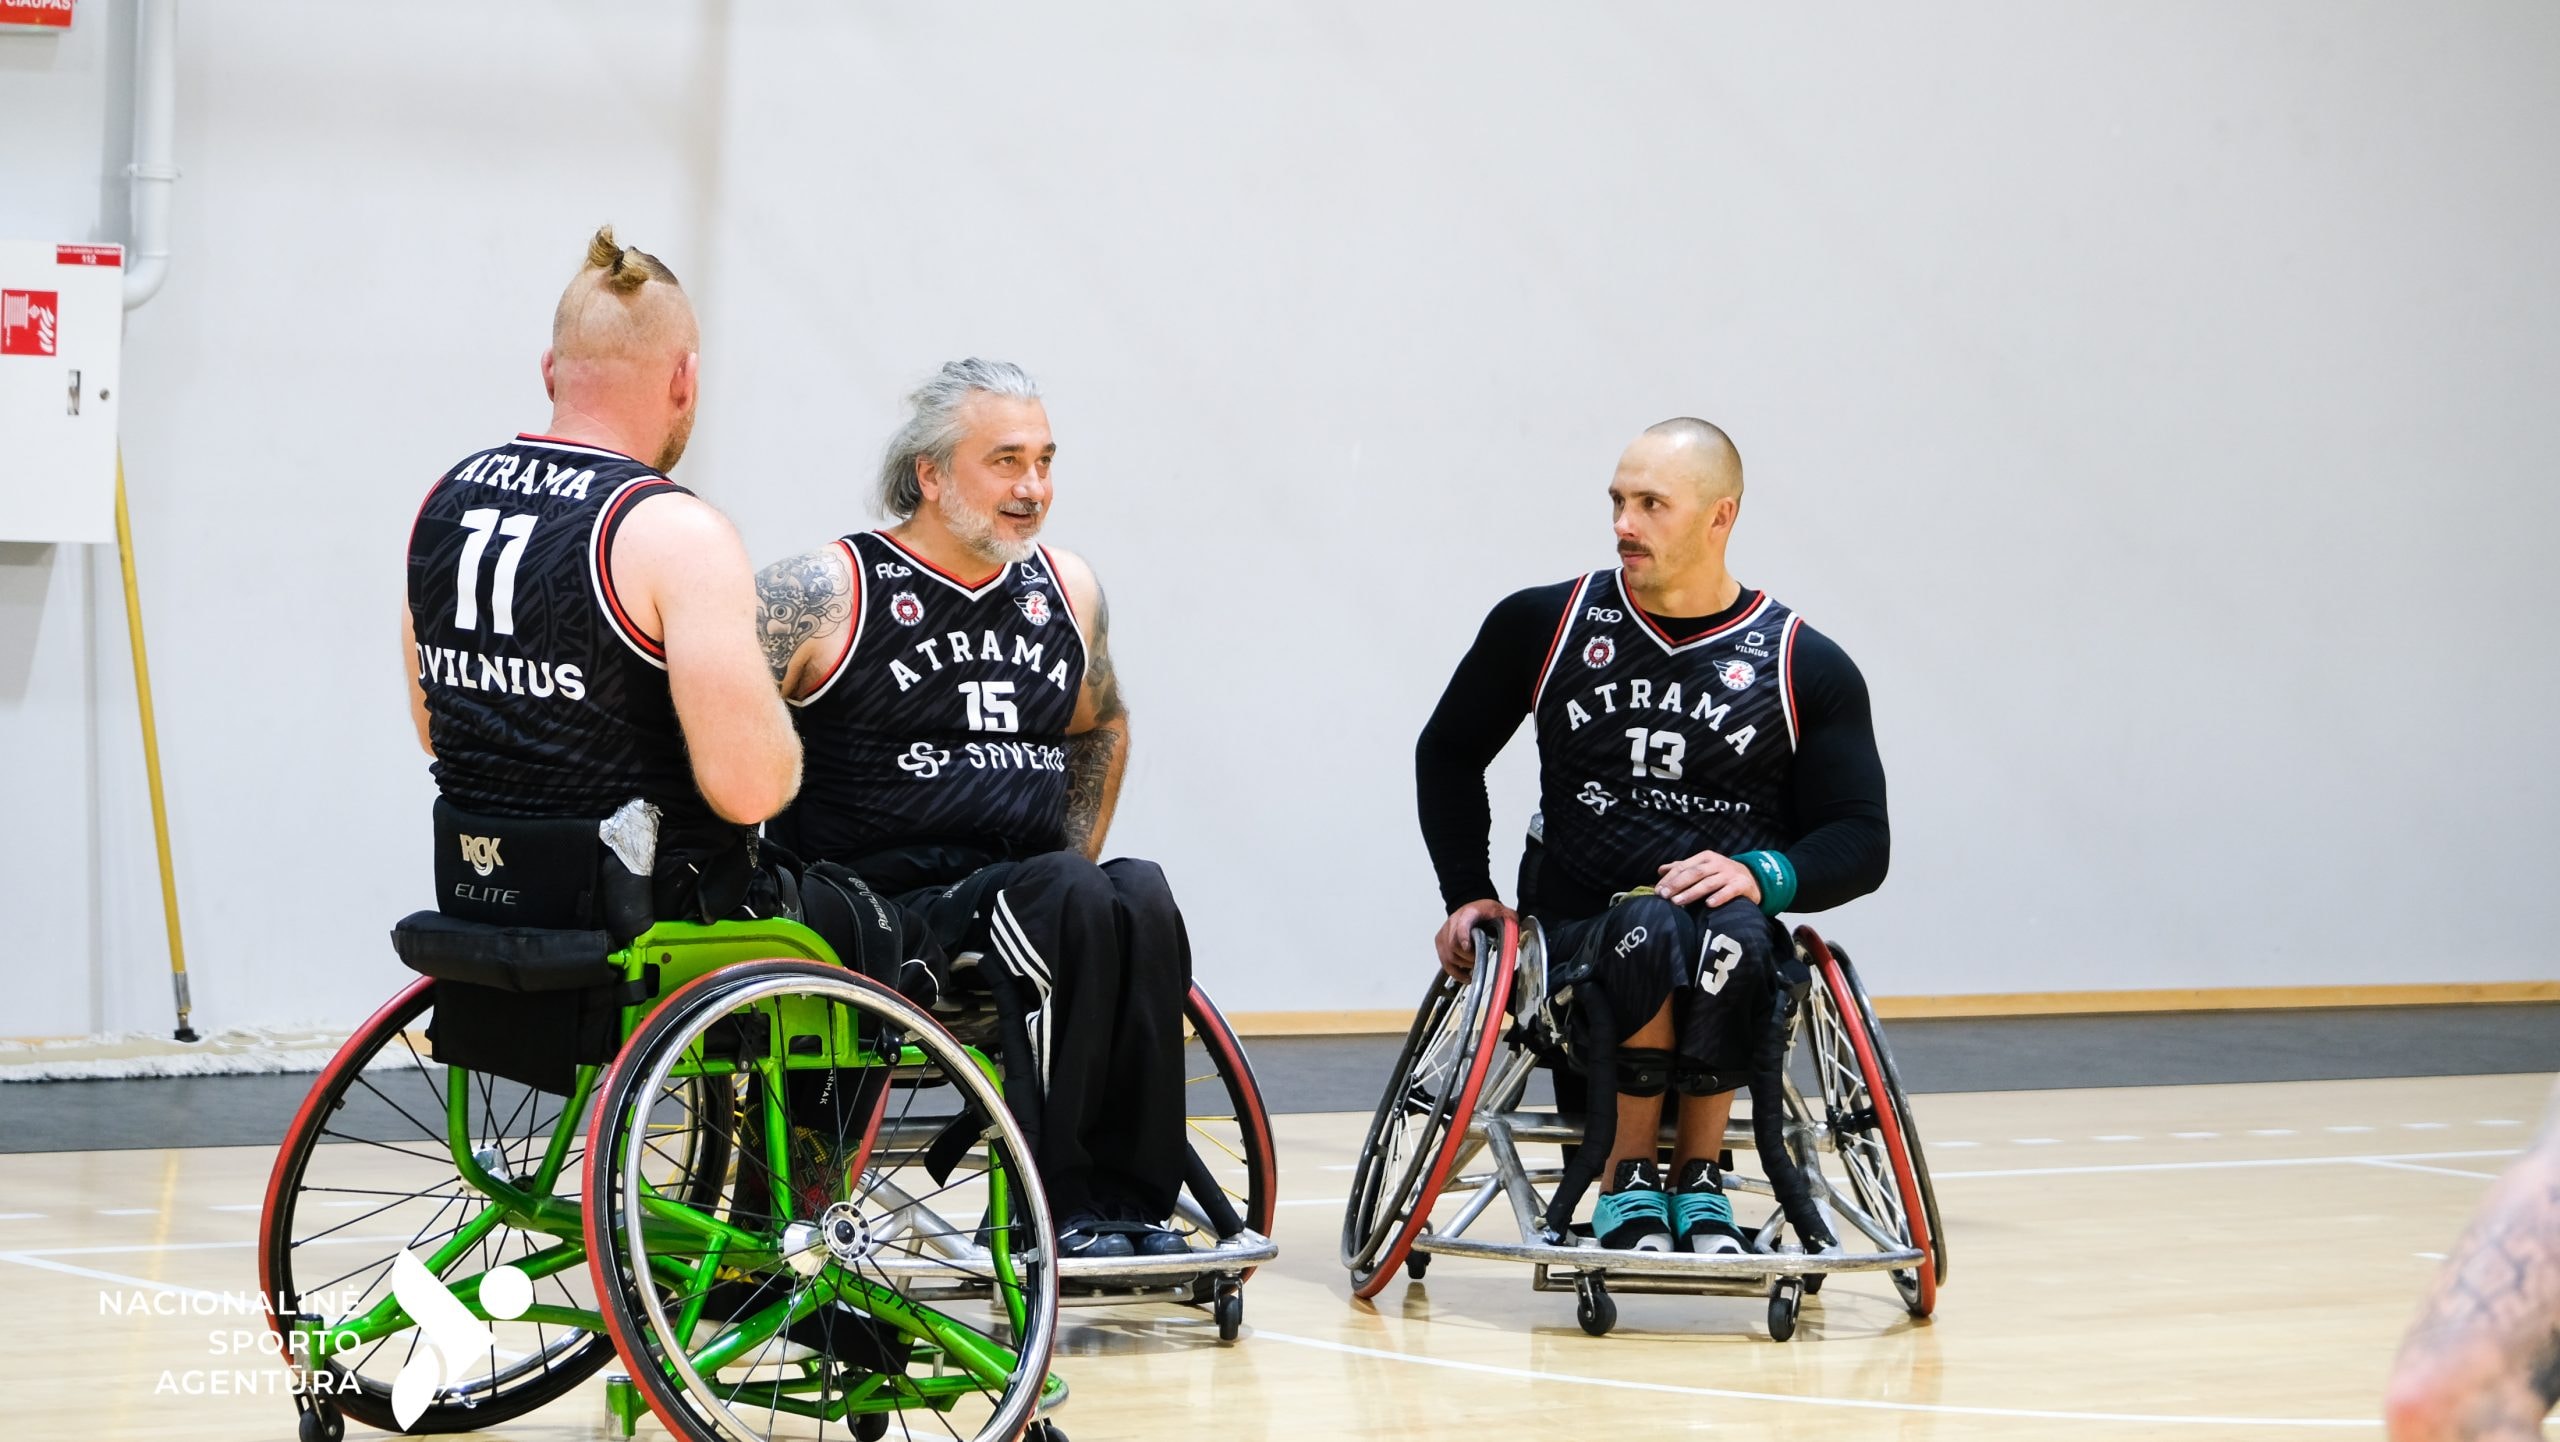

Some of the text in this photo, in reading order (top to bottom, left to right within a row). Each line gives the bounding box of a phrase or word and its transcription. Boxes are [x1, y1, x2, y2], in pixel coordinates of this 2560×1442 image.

[454, 453, 596, 501] ATRAMA
[455, 507, 539, 635] 11
[888, 629, 1069, 692] ATRAMA
[1735, 644, 1769, 657] VILNIUS
[958, 681, 1018, 733] 15
[1566, 679, 1757, 756] ATRAMA
[1625, 727, 1686, 780] 13
[454, 883, 520, 905] ELITE
